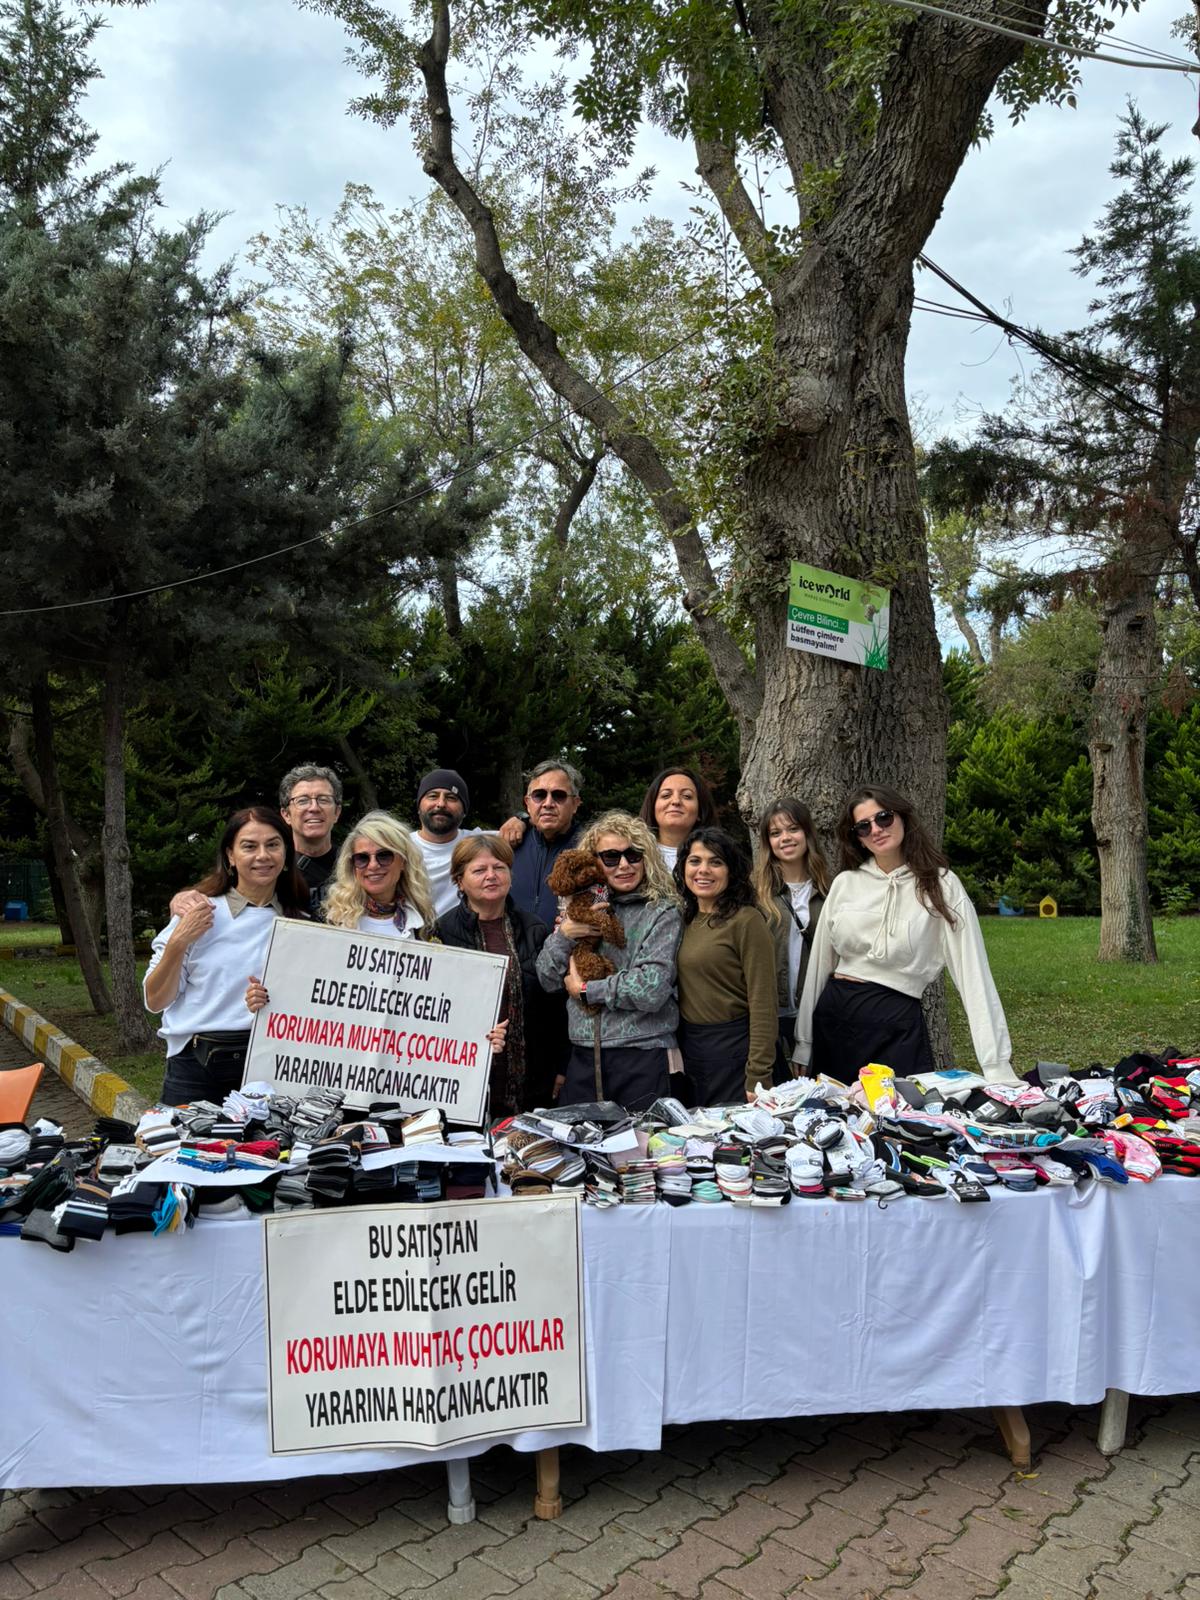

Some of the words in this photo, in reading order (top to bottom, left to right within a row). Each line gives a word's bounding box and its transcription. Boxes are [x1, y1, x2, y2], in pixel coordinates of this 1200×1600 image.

[791, 607, 815, 622] Çevre
[791, 623, 815, 636] Lütfen
[816, 630, 845, 644] çimlere
[790, 633, 838, 651] basmayalım!
[347, 944, 368, 971] BU
[368, 948, 433, 982] SATIŞTAN
[311, 978, 348, 1008] ELDE
[348, 980, 413, 1017] EDİLECEK
[413, 992, 452, 1024] GELİR
[266, 1012, 345, 1048] KORUMAYA
[346, 1024, 407, 1063] MUHTAÇ
[407, 1032, 478, 1067] ÇOCUKLAR
[274, 1054, 343, 1089] YARARINA
[345, 1064, 460, 1105] HARCANACAKTIR
[368, 1225, 392, 1259] BU
[397, 1219, 478, 1266] SATIŞTAN
[333, 1278, 379, 1315] ELDE
[382, 1269, 462, 1313] EDİLECEK
[466, 1261, 517, 1306] GELİR
[286, 1331, 390, 1375] KORUMAYA
[393, 1326, 464, 1372] MUHTAÇ
[468, 1317, 565, 1370] ÇOCUKLAR
[305, 1386, 399, 1428] YARARINA
[402, 1371, 549, 1424] HARCANACAKTIR
